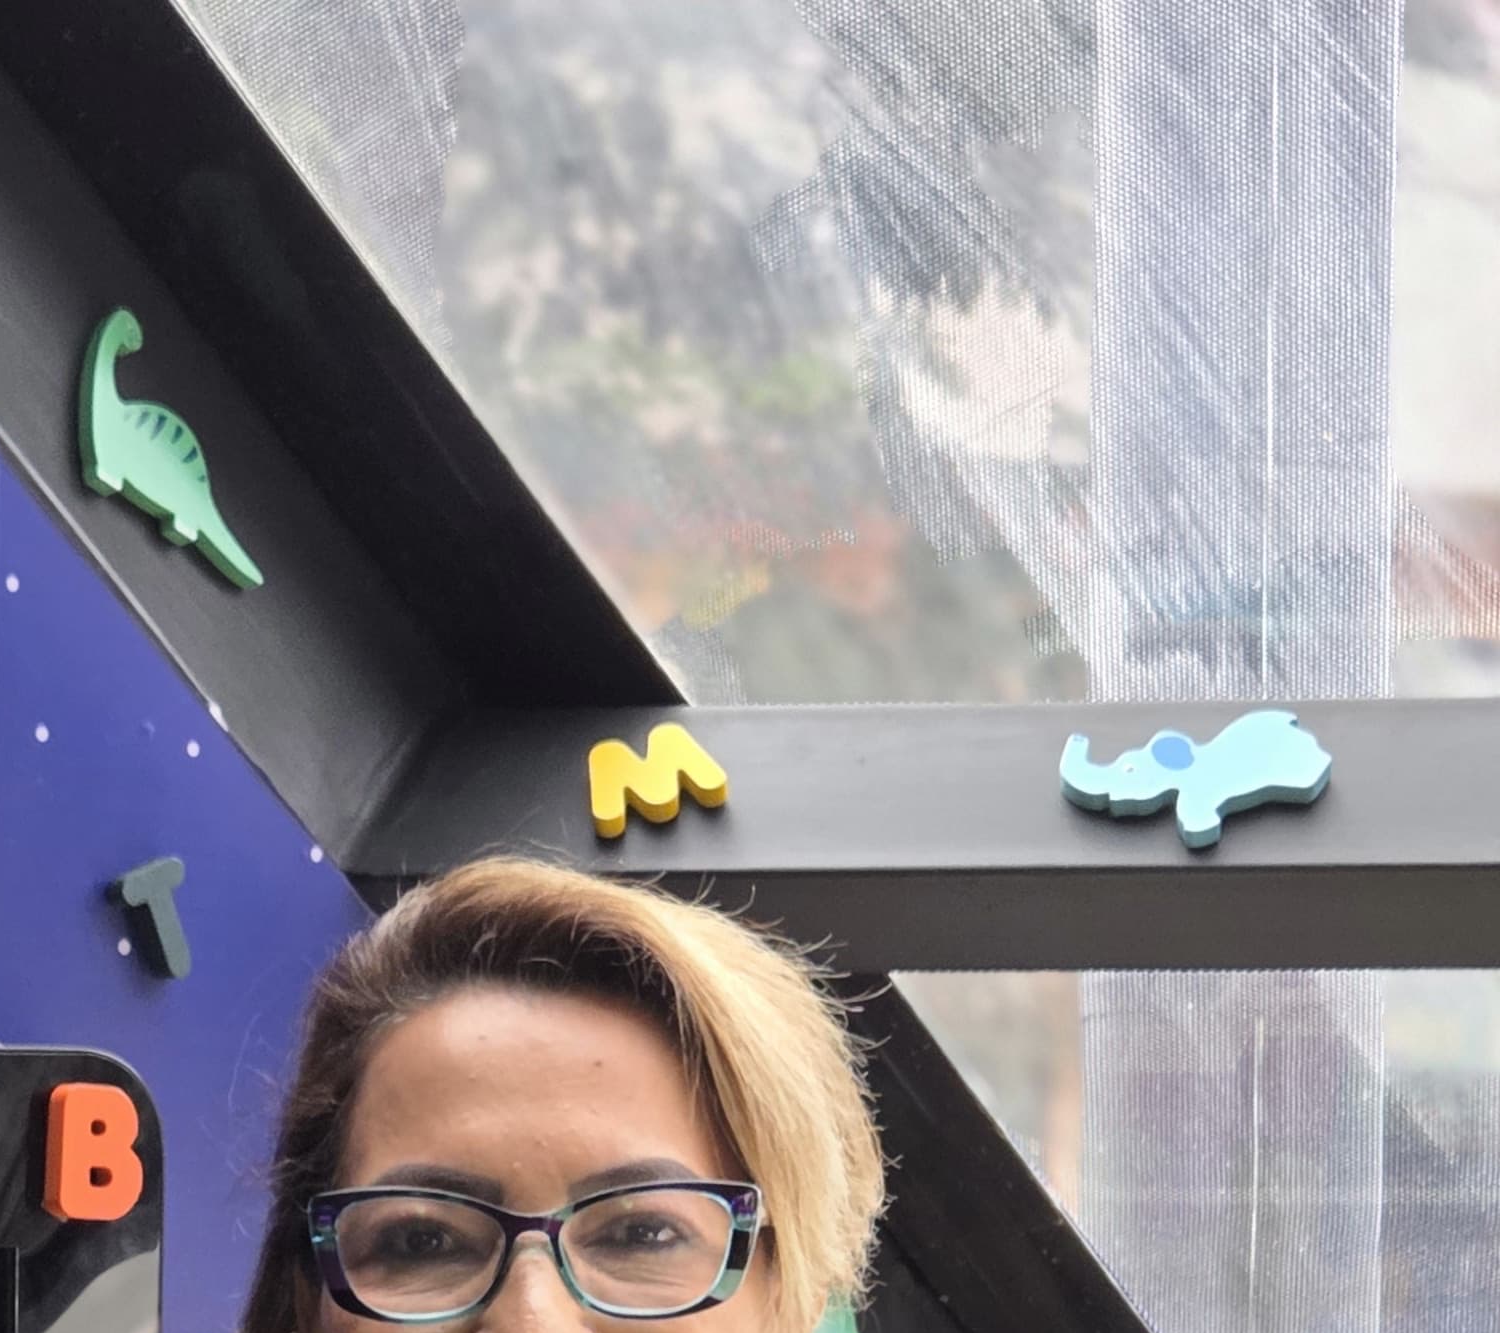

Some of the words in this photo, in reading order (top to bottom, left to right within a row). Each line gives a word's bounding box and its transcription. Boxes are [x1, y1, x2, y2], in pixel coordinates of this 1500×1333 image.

[588, 723, 727, 838] M
[116, 856, 190, 979] T
[44, 1082, 143, 1220] B
